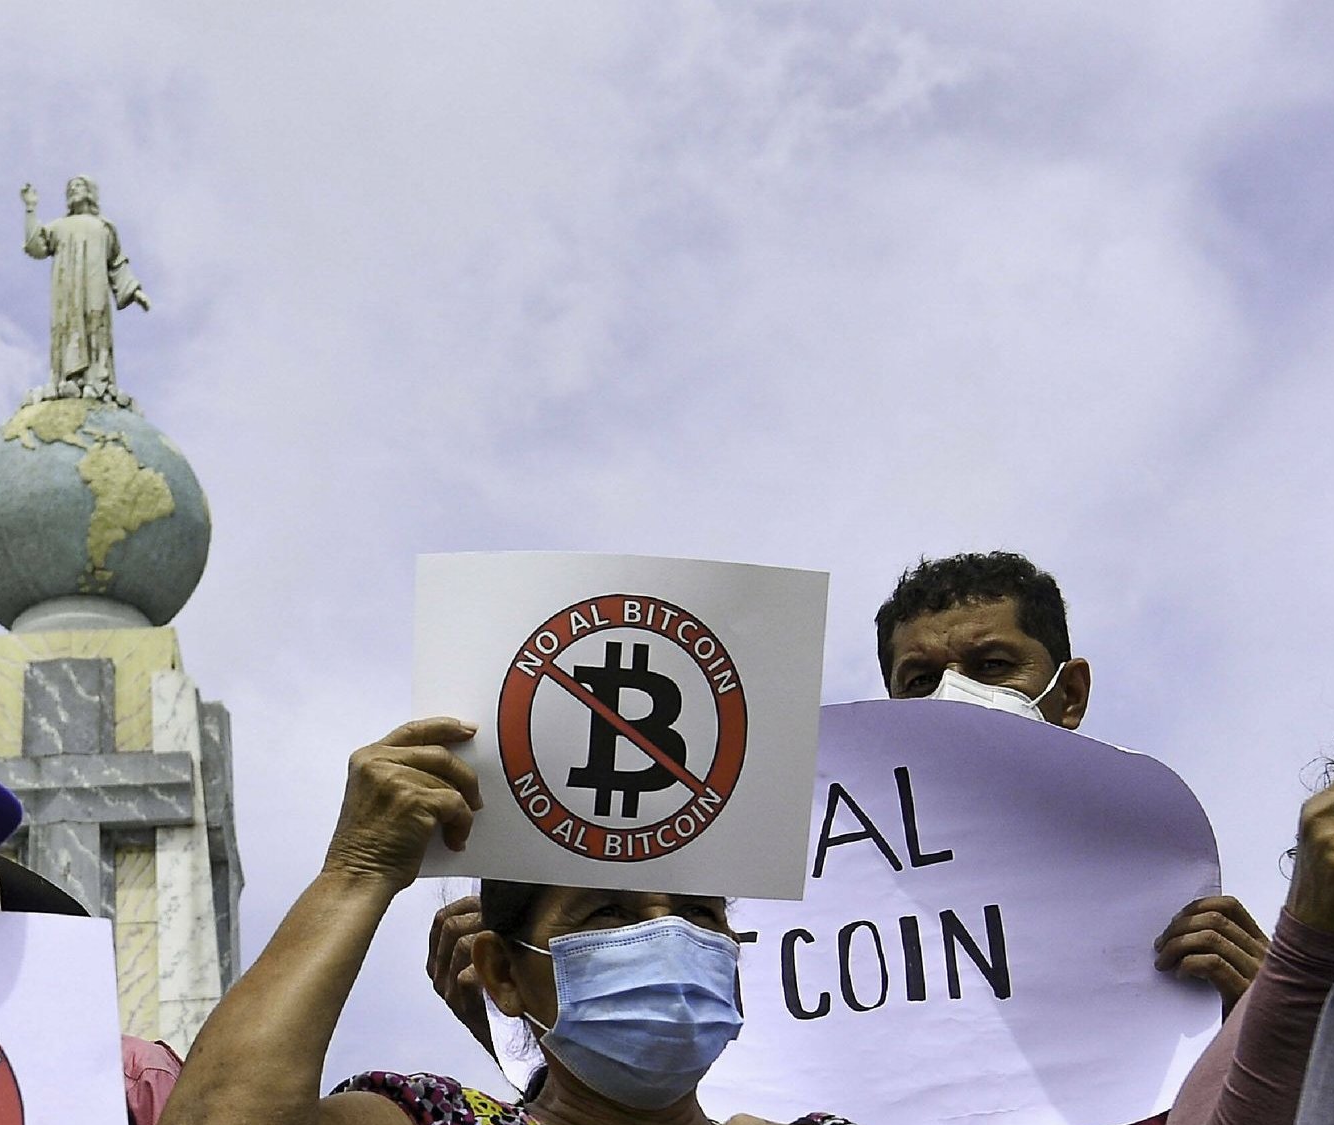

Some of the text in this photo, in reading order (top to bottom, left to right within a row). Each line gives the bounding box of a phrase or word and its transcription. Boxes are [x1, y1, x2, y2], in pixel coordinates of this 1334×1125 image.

[516, 600, 736, 695] NO AL BITCOIN
[514, 772, 722, 856] NO AL BITCOIN
[812, 766, 953, 878] AL
